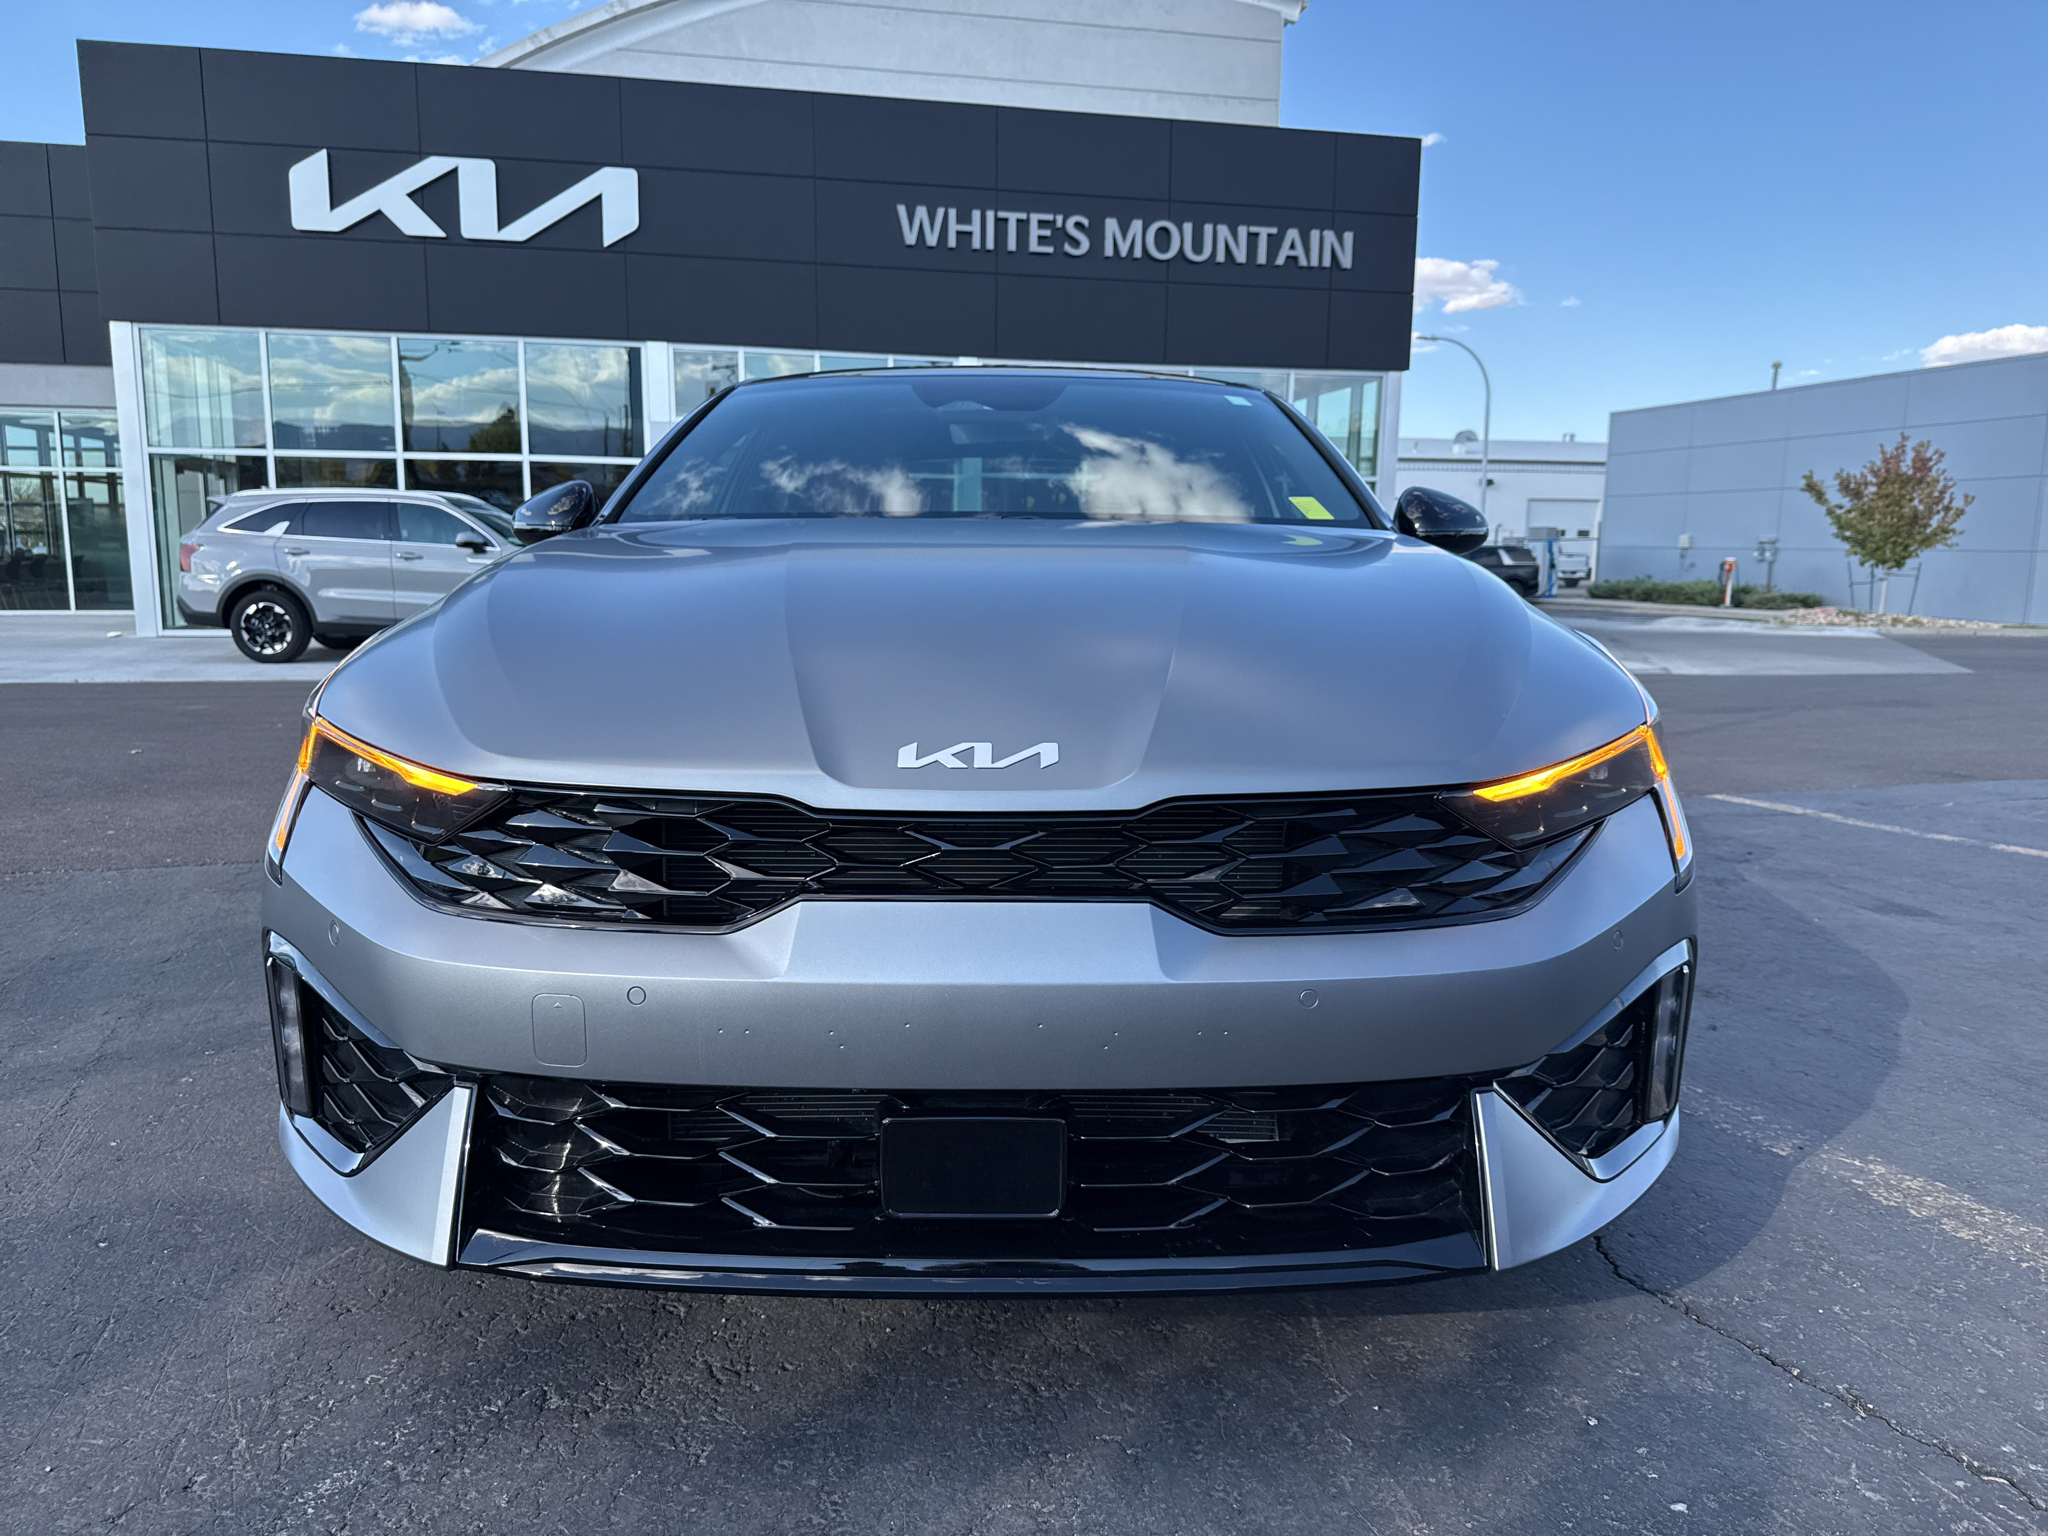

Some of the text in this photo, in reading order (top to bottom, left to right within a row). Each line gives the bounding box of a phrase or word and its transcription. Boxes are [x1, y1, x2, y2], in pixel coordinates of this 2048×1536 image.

[289, 148, 639, 248] KIA
[896, 203, 1354, 269] WHITE'S MOUNTAIN
[897, 741, 1060, 769] KIA
